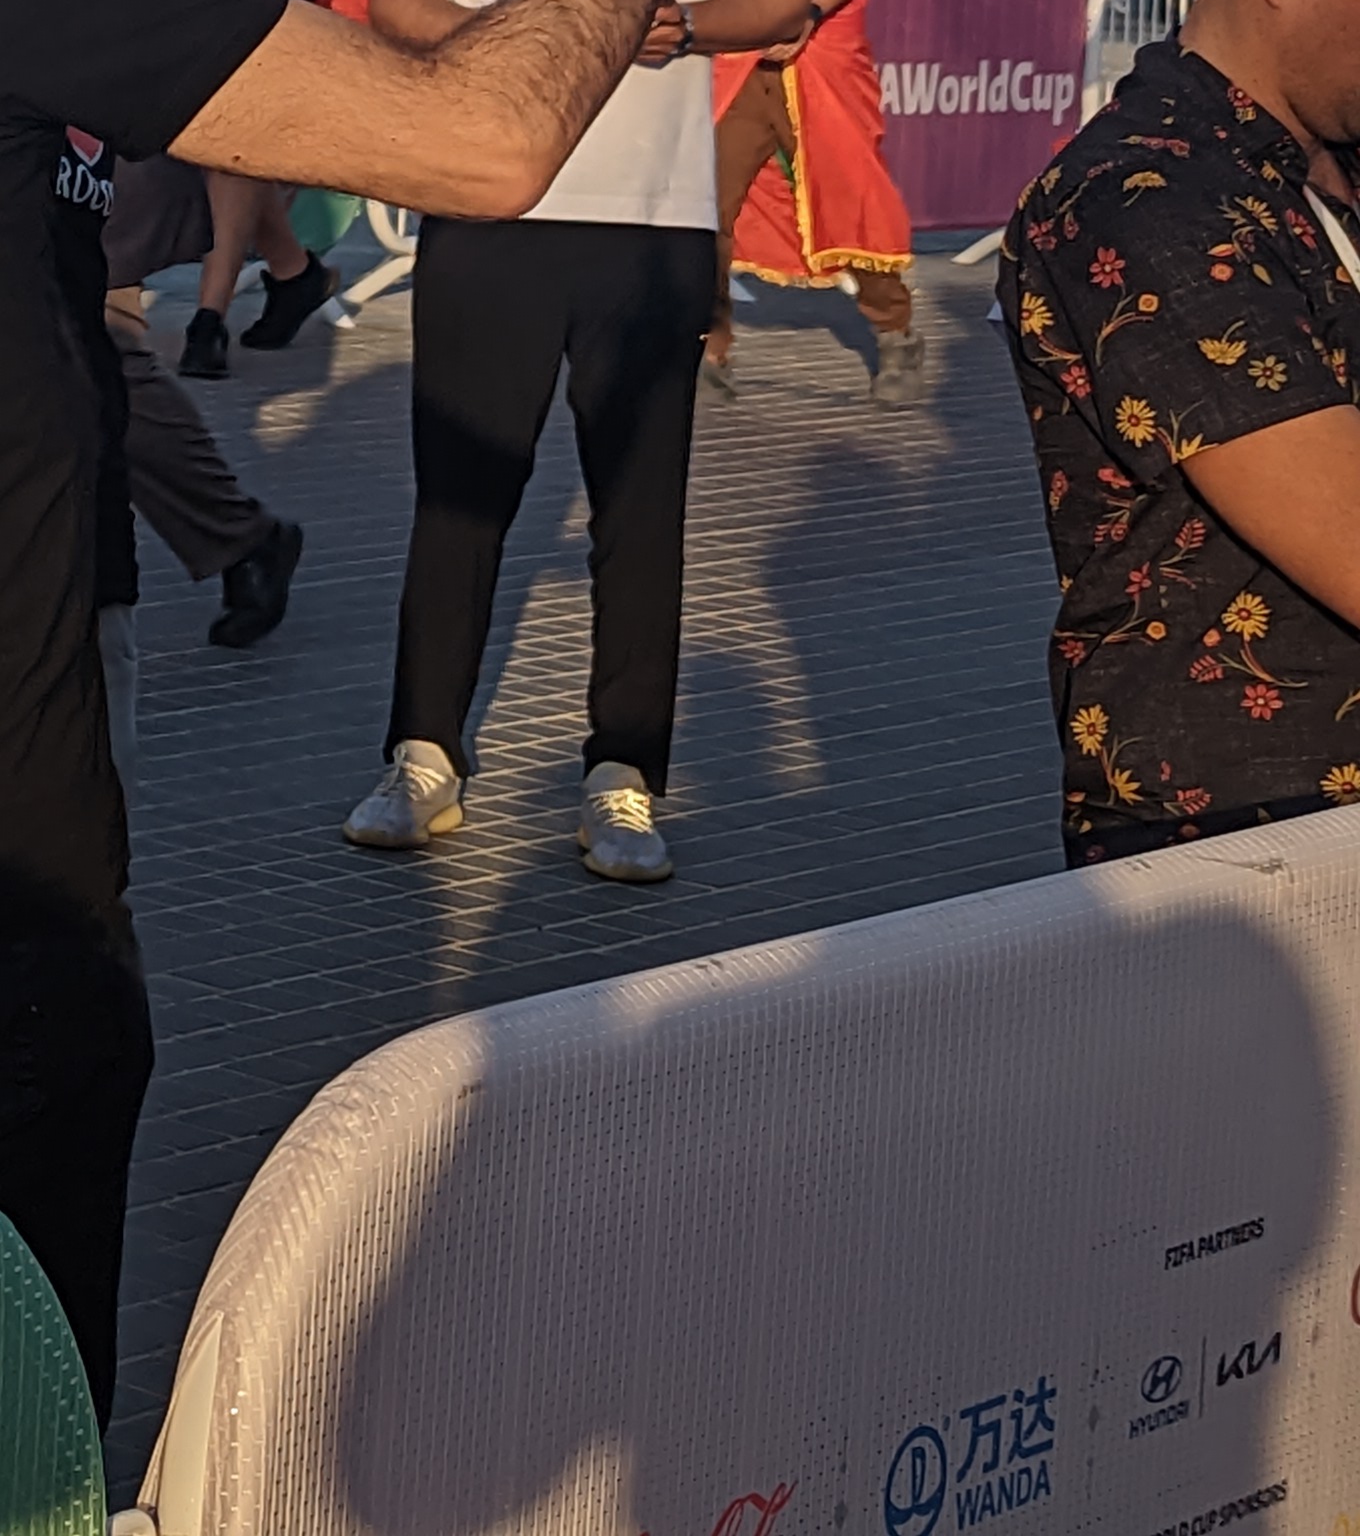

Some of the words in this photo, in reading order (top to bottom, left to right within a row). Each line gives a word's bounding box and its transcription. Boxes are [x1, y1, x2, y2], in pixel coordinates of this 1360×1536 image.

[874, 60, 1076, 126] AWorldCup
[1164, 1240, 1196, 1270] FIFA
[956, 1375, 1057, 1483] 万达
[956, 1460, 1051, 1531] WANDA
